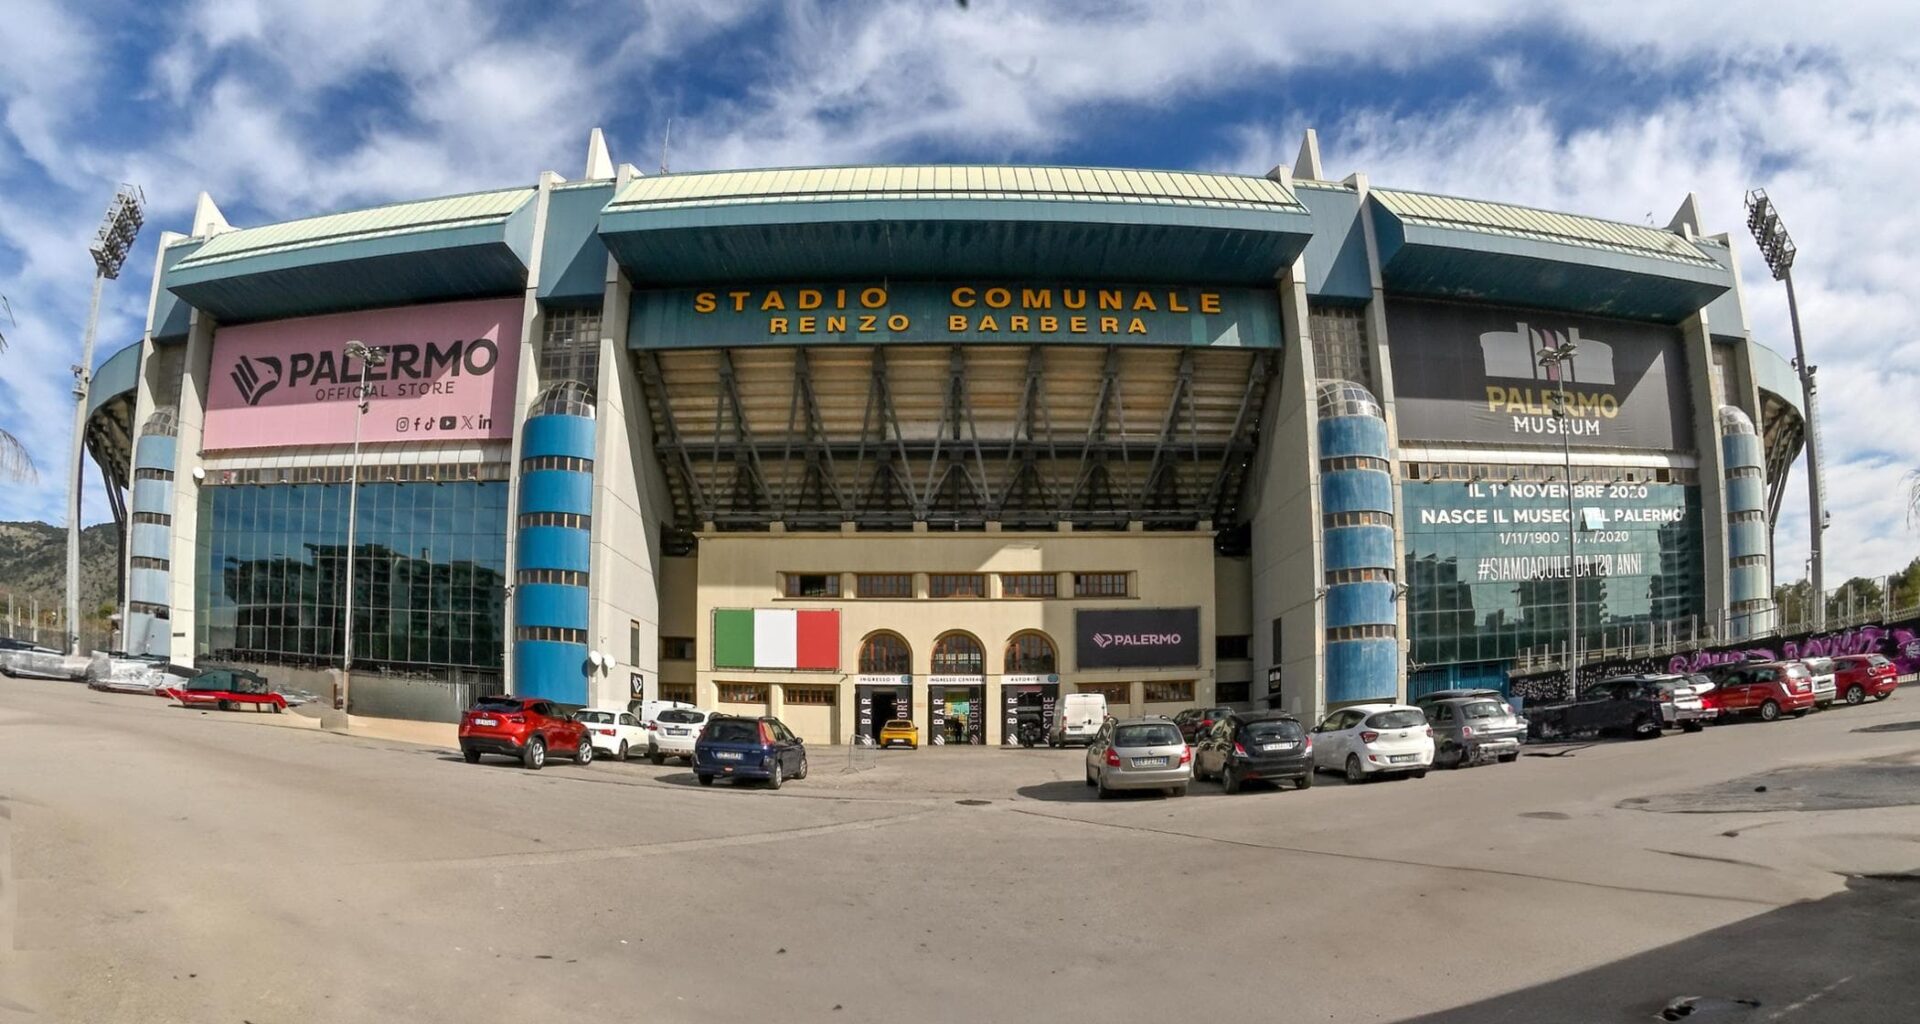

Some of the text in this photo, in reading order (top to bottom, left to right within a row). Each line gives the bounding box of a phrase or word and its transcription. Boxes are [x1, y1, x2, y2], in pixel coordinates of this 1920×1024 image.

[695, 287, 1222, 313] STADIO COMUNALE
[769, 314, 1147, 334] RENZO BARBERA
[288, 338, 499, 388] PALERMO
[315, 381, 455, 401] OFFICAL STORE
[1486, 386, 1619, 419] PALERMO
[1513, 416, 1600, 436] MUSEUM
[1469, 485, 1485, 498] IL
[1510, 484, 1603, 498] NOVEMBRE
[1609, 485, 1648, 499] 2020
[1421, 509, 1488, 524] NASCE
[1494, 509, 1509, 524] IL
[1514, 509, 1575, 523] MUSEO
[1615, 509, 1684, 522] PALERMO
[1499, 532, 1560, 545] 1/11/1900
[1477, 553, 1642, 581] #SIAMOAQUILE DA 120 ANNI
[1114, 633, 1181, 646] PALERMO
[861, 697, 872, 725] BAR
[933, 697, 944, 725] BAR
[969, 697, 979, 731] STORE
[1007, 697, 1018, 725] BAR
[1042, 696, 1055, 729] STORE
